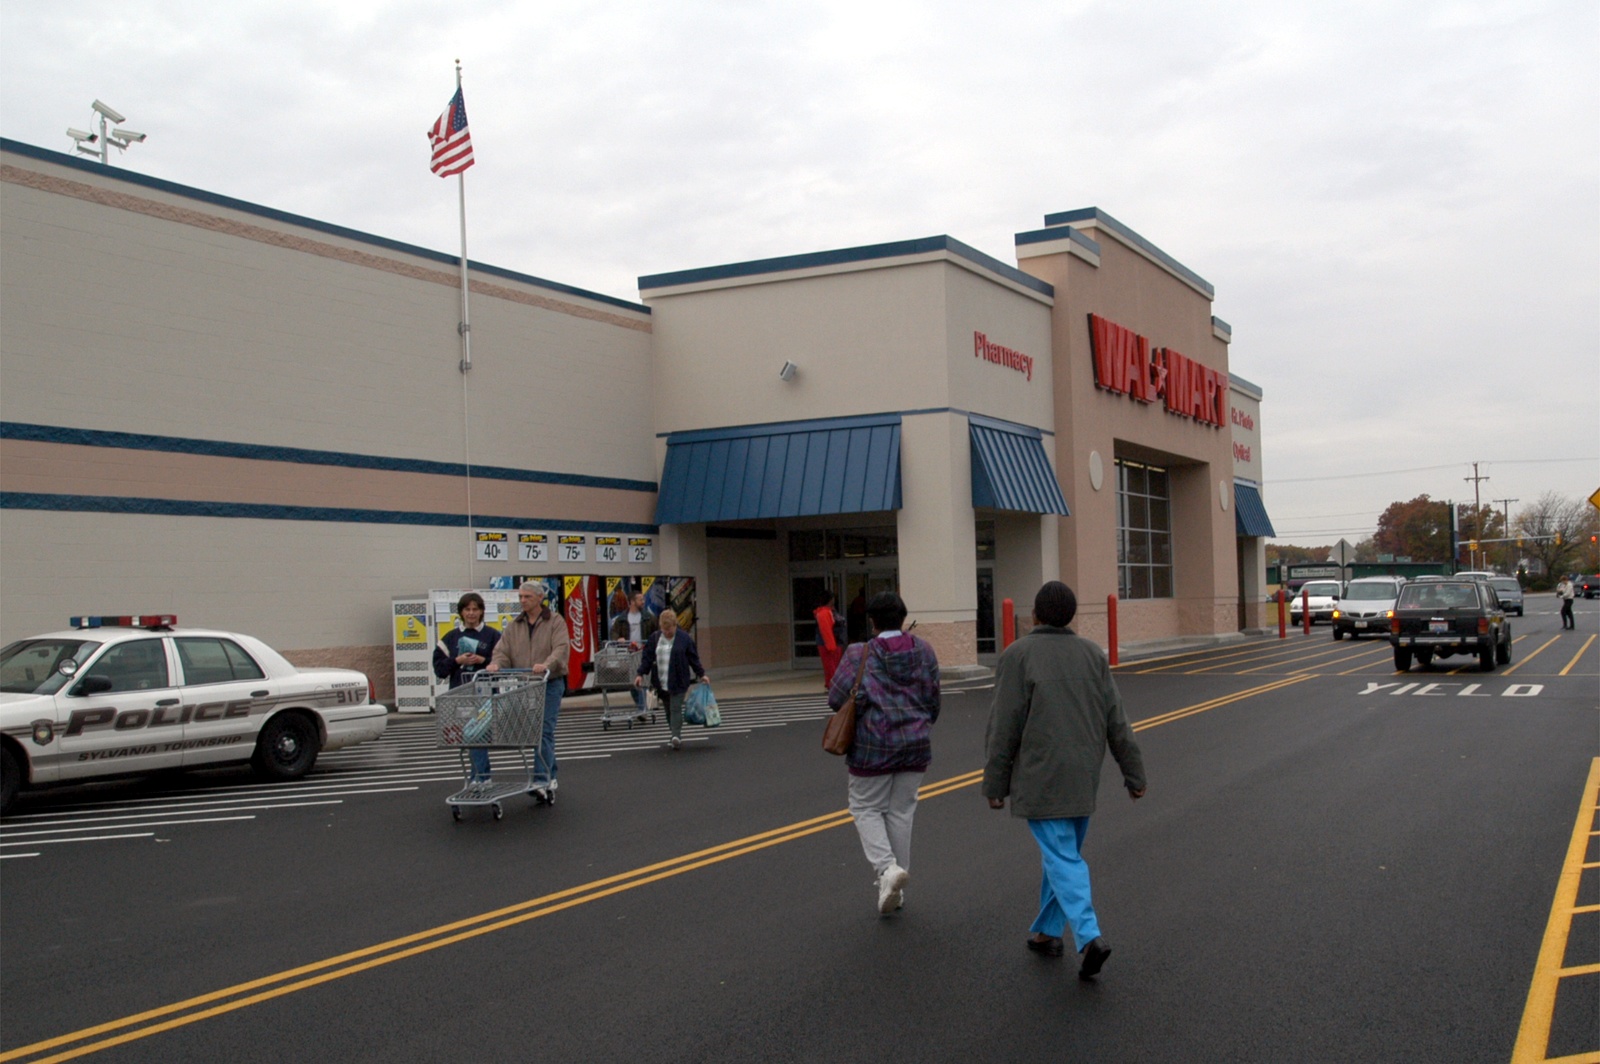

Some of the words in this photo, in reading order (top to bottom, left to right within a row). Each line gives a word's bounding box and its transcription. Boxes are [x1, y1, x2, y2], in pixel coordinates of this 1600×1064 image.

[974, 330, 1034, 382] Pharmacy
[1357, 682, 1545, 697] YIELD
[78, 745, 157, 762] SYLVANIA
[163, 735, 242, 752] TOWNSHIP
